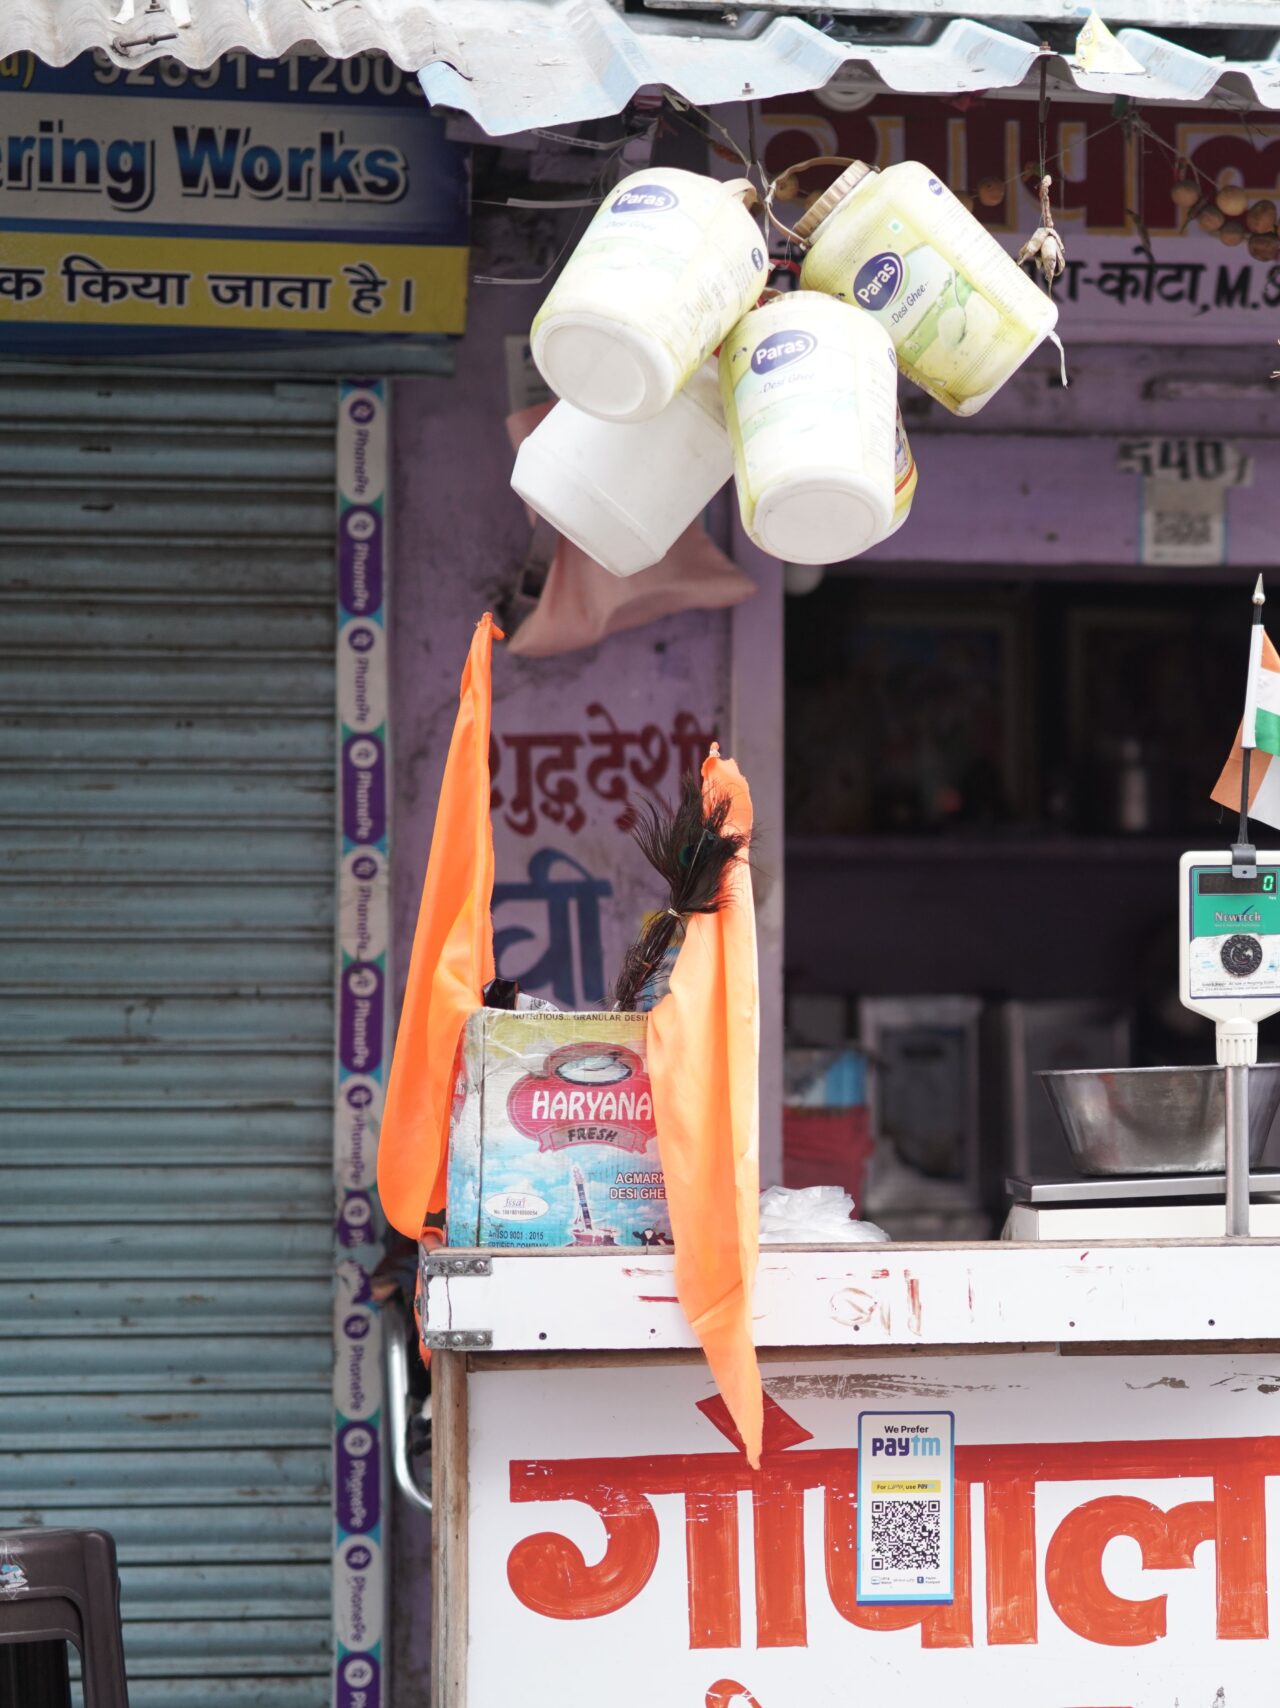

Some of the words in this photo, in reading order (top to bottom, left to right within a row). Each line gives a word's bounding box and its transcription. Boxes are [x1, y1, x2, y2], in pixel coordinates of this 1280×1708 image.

[0, 120, 155, 212] ring
[172, 126, 412, 204] Works
[616, 192, 667, 208] Paras
[61, 254, 191, 305] किया
[207, 273, 333, 309] जाता
[856, 262, 897, 304] Paras
[755, 339, 806, 365] Paras
[1262, 875, 1274, 892] 0
[531, 1090, 653, 1122] HARYANA
[567, 1126, 618, 1143] FRESH
[610, 1188, 638, 1200] DESI
[640, 1188, 667, 1200] GHE
[884, 1425, 899, 1434] We
[900, 1425, 929, 1434] Prefer
